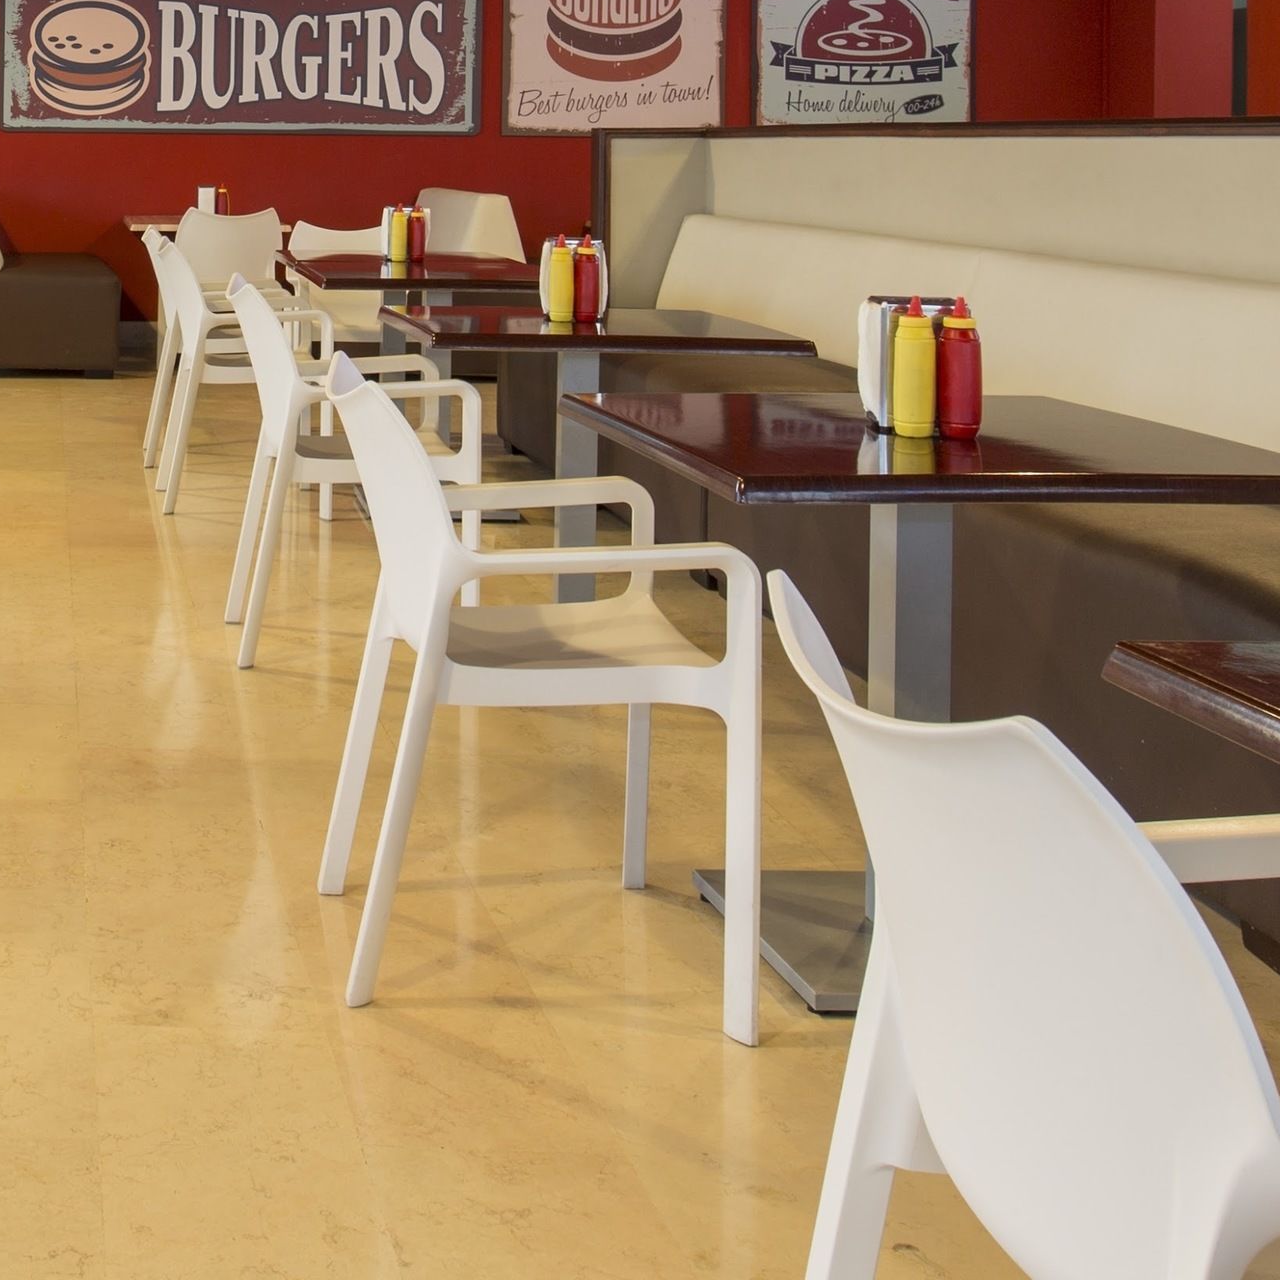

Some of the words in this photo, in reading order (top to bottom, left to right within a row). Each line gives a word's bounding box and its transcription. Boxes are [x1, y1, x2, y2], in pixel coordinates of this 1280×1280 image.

[156, 0, 446, 116] BURGERS
[814, 64, 915, 82] PIZZA
[517, 89, 567, 117] Best
[566, 87, 628, 123] burgers
[636, 83, 657, 106] in
[660, 75, 714, 104] town!
[785, 90, 835, 113] Home
[838, 89, 898, 123] delivery
